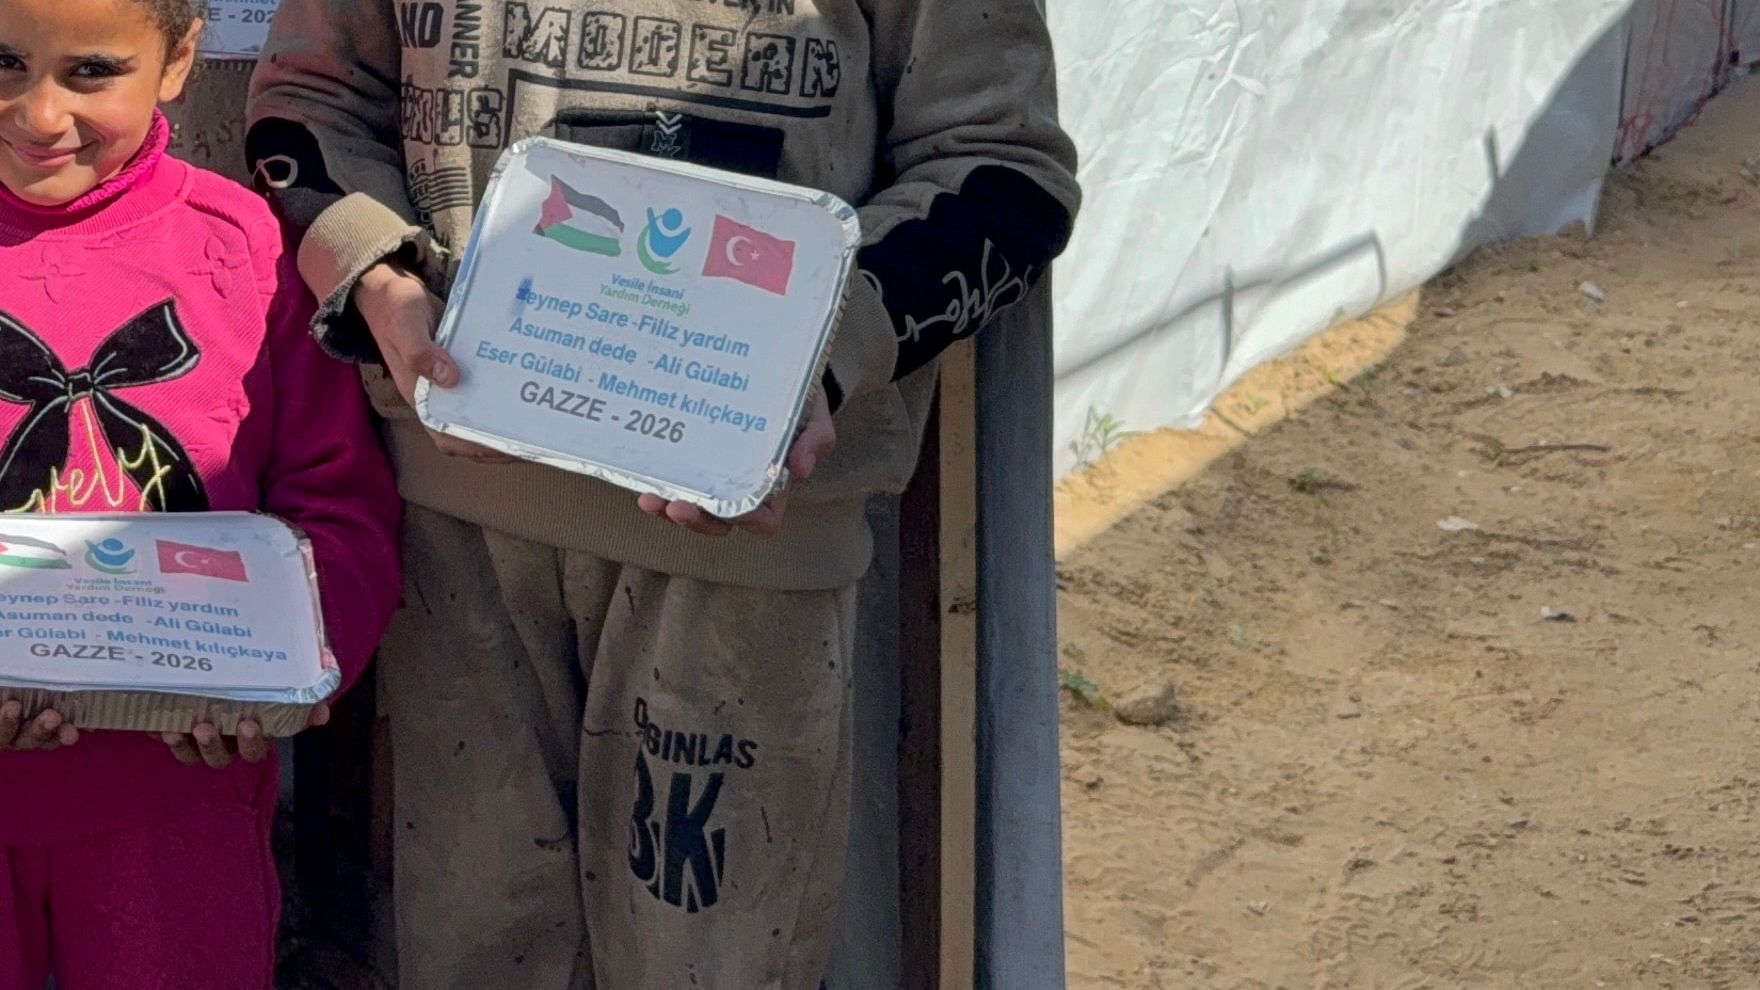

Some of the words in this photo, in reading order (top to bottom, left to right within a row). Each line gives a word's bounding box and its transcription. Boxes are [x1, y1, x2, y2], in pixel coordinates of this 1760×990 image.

[241, 9, 277, 24] 202
[584, 302, 629, 328] Sare
[682, 327, 750, 357] yardım
[508, 316, 586, 351] Asuman
[588, 335, 638, 364] dede
[647, 354, 683, 380] -Ali
[684, 360, 750, 393] Gülabi
[475, 340, 518, 366] Eser
[520, 350, 582, 384] Gülabi
[597, 372, 677, 409] Mehmet
[680, 391, 767, 433] kılıçkaya
[519, 381, 607, 422] GAZZE
[623, 409, 686, 444] 2026
[63, 591, 110, 607] Sare
[166, 597, 239, 618] yardım
[17, 624, 86, 641] Gülabi
[106, 629, 192, 651] Mehmet
[195, 636, 288, 662] kılıçkaya
[77, 609, 133, 624] dede
[145, 615, 188, 630] -Ali
[191, 617, 253, 639] Gülabi
[29, 642, 126, 662] GAZZE
[150, 650, 213, 673] 2026
